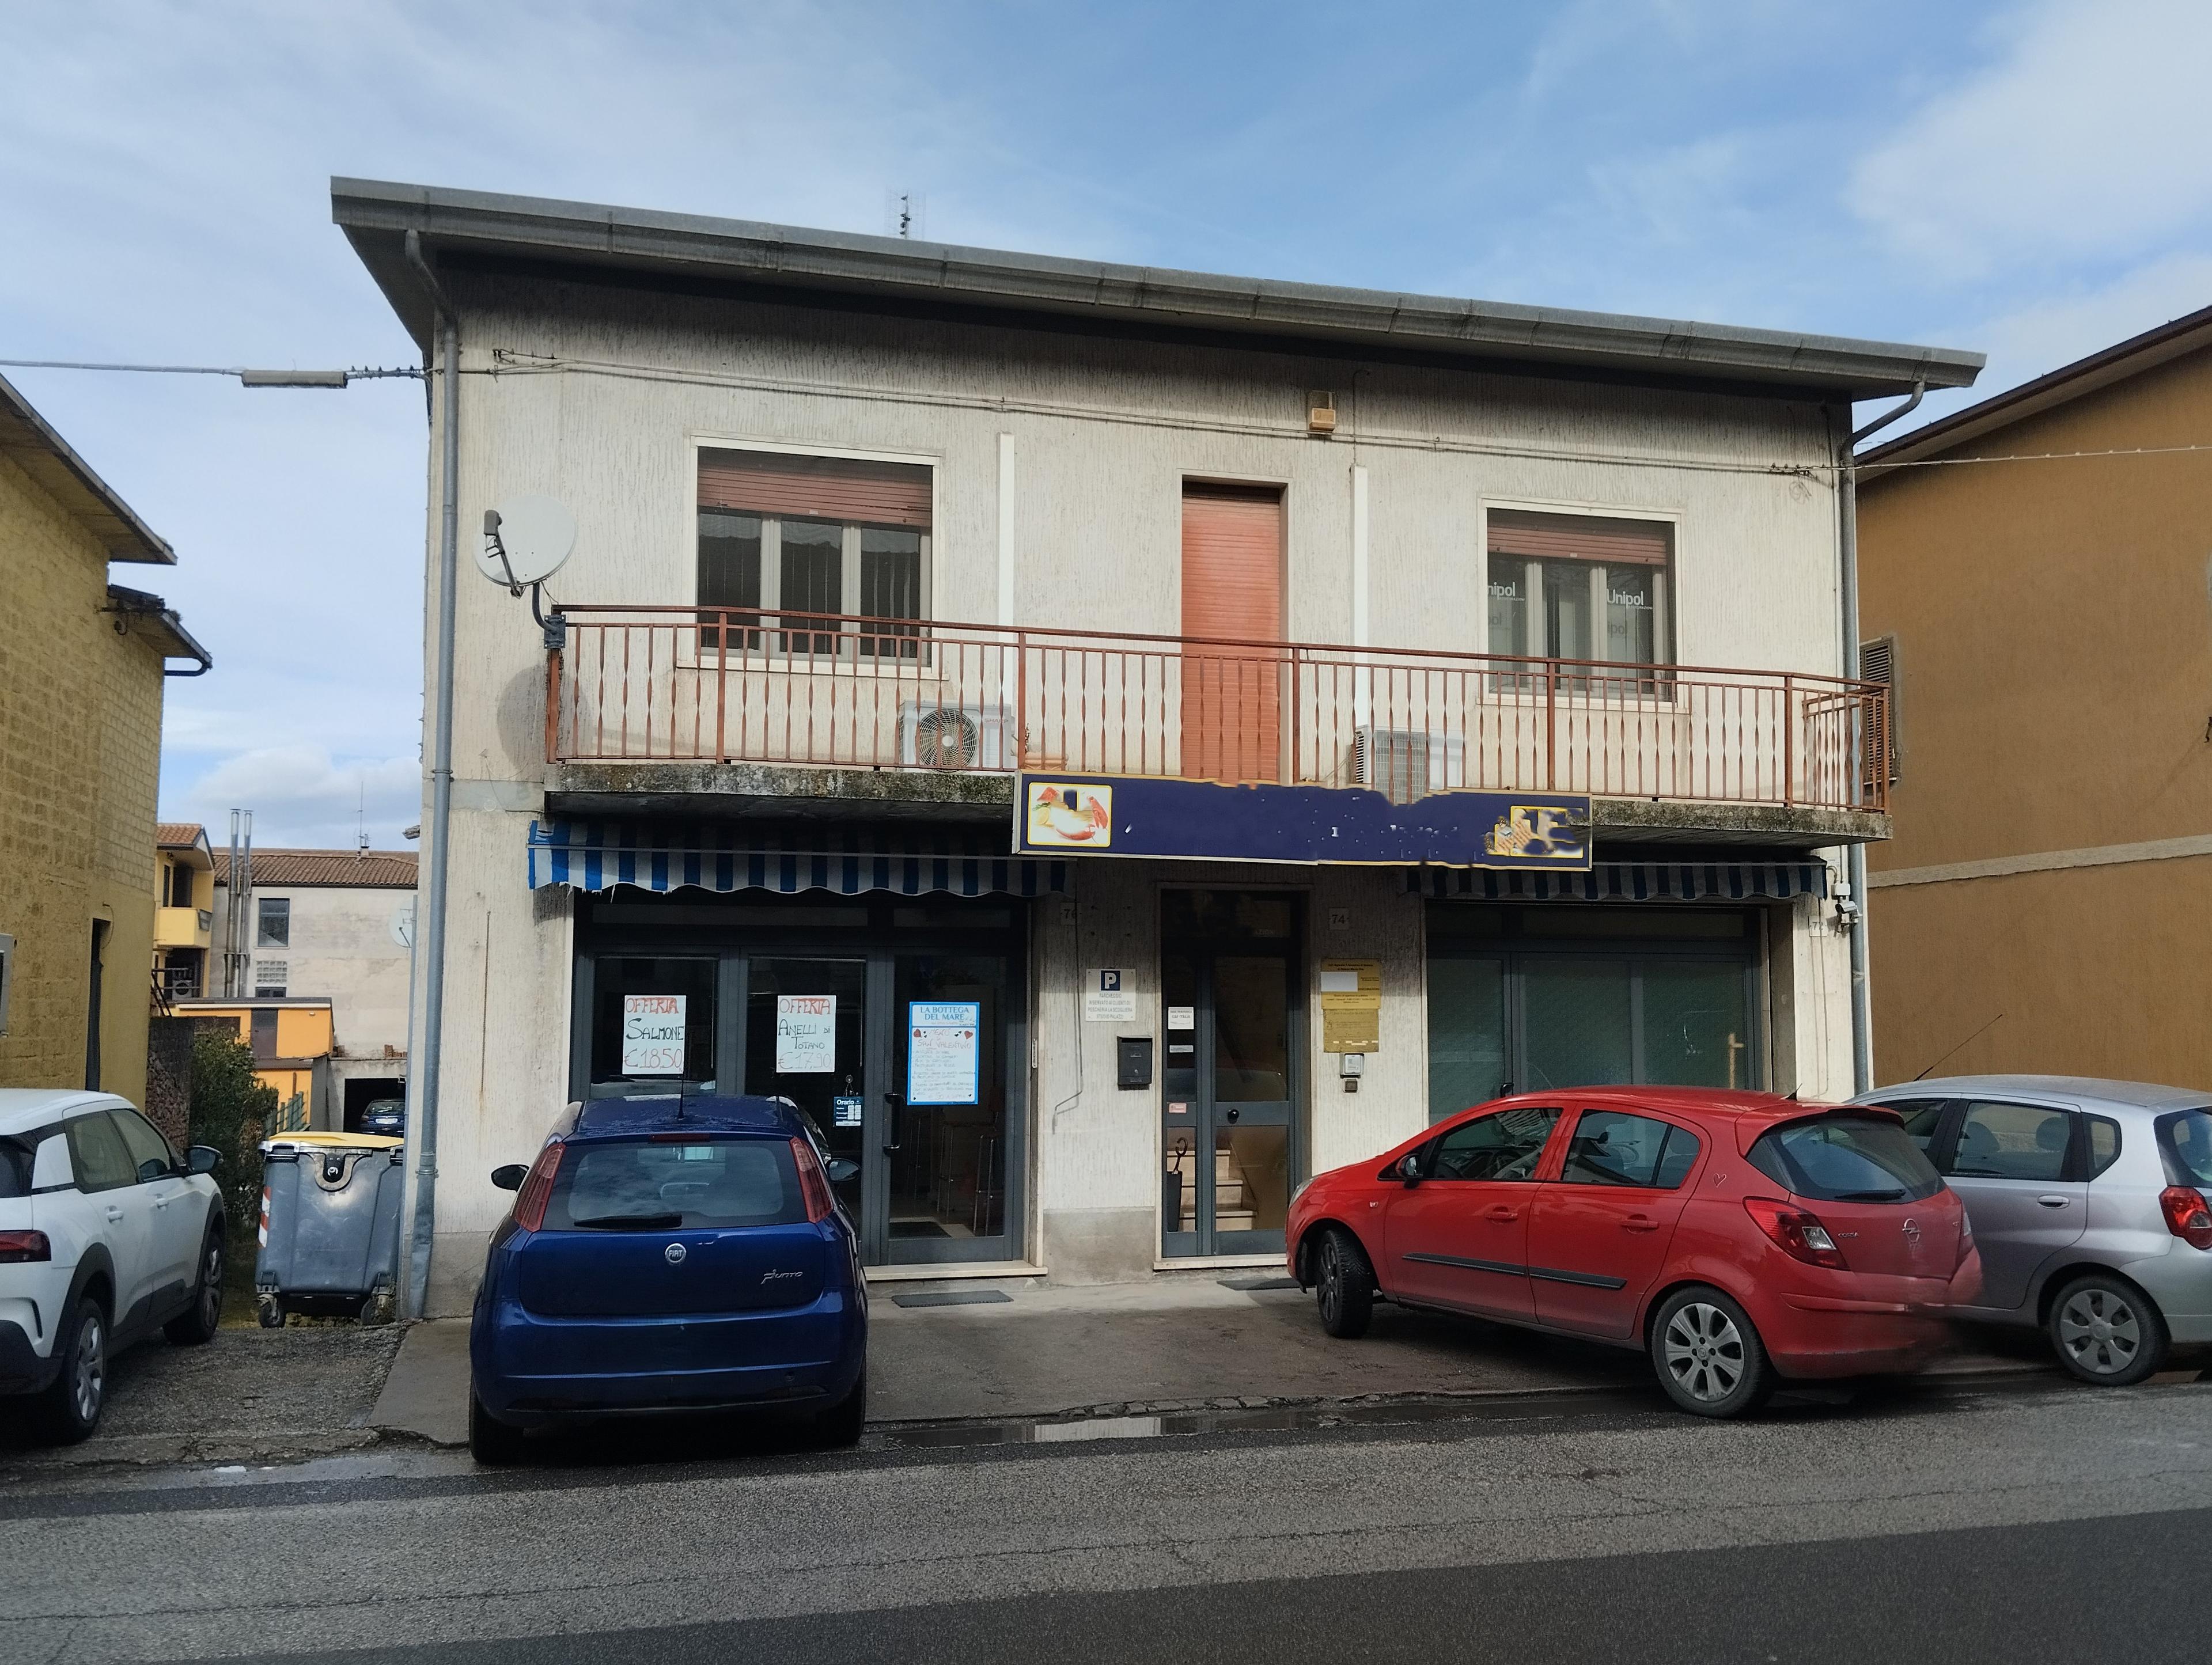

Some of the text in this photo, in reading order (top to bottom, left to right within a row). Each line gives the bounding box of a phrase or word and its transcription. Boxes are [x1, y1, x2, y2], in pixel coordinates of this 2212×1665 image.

[1487, 582, 1516, 600] nipol
[1607, 589, 1644, 609] Unipol
[1332, 914, 1346, 924] 74
[1105, 972, 1117, 989] P
[626, 997, 679, 1014] OFFERTA
[779, 998, 831, 1015] OFFERTA
[626, 1018, 684, 1040] SALMONE
[778, 1018, 831, 1036] ANELLI DI
[791, 1036, 825, 1049] TOTANO
[917, 1038, 932, 1047] SAN
[935, 1040, 972, 1049] VALENTINO
